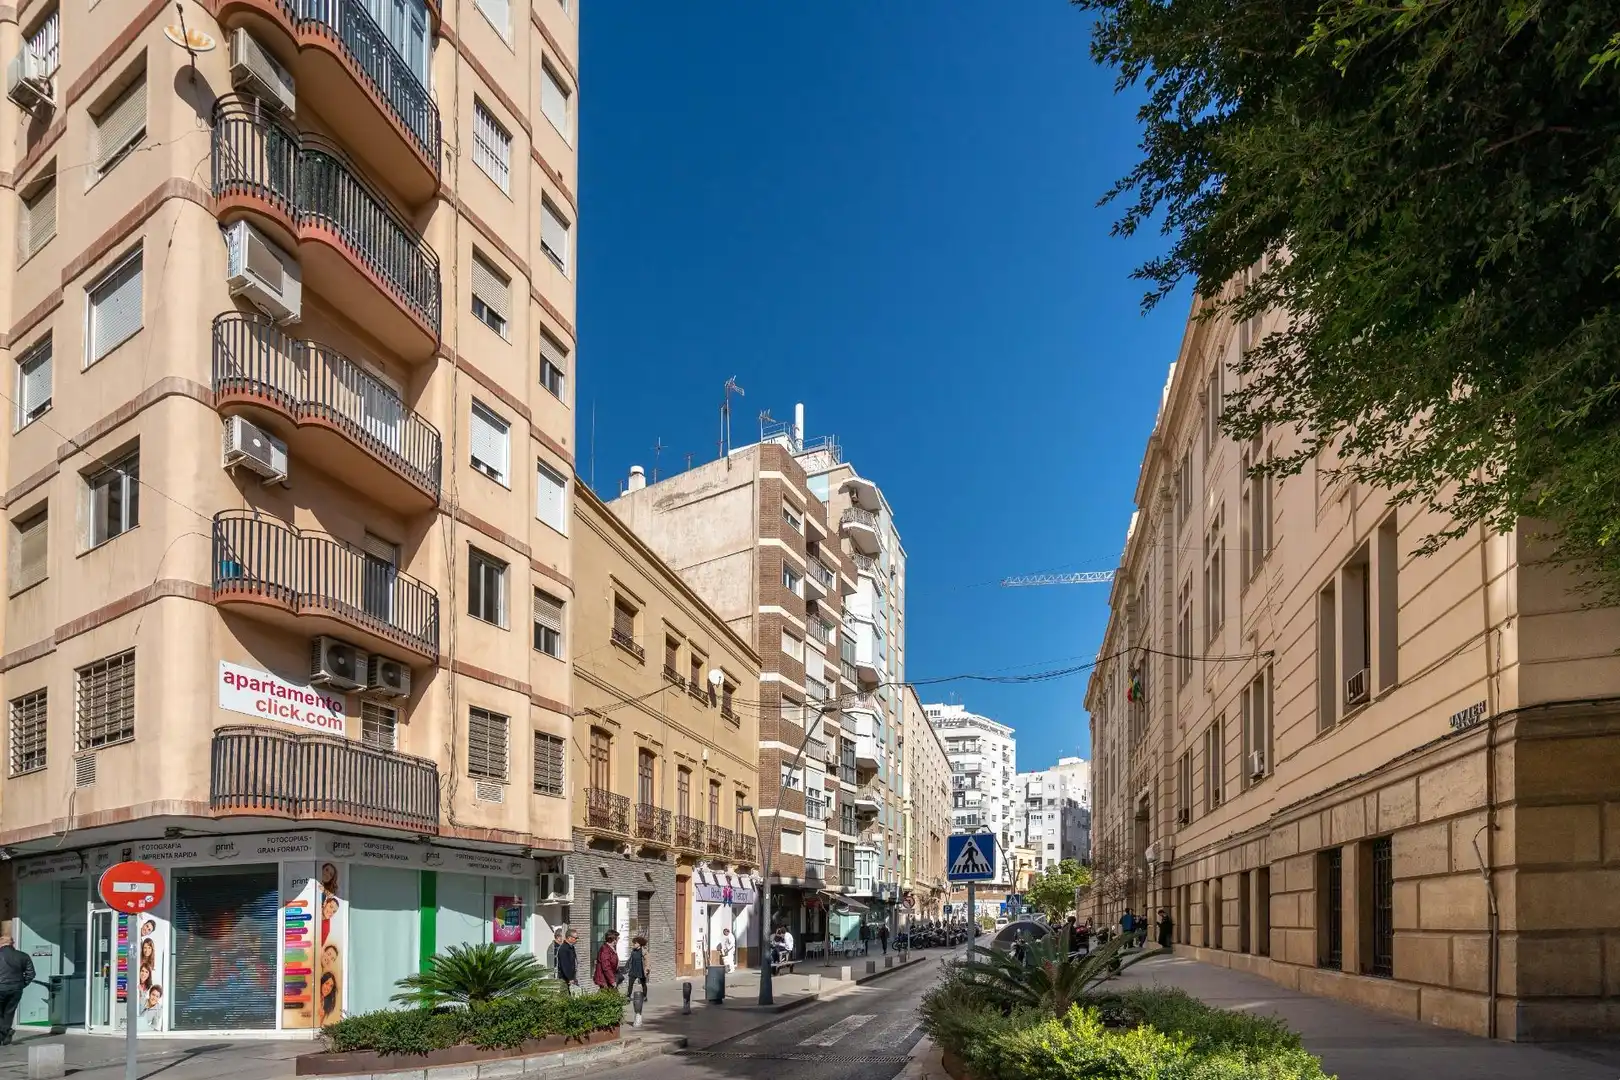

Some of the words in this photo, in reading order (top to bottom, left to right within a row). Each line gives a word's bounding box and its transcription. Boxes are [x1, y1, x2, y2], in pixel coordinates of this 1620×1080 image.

[223, 670, 343, 713] apartamento
[255, 697, 343, 731] click.com
[1450, 701, 1484, 726] JAVIER
[267, 836, 309, 844] FOTOCOPIAS
[332, 840, 351, 852] print
[215, 841, 235, 855] print
[277, 845, 309, 853] FORMATO
[142, 853, 172, 861] IMPRENTA
[291, 878, 309, 888] print
